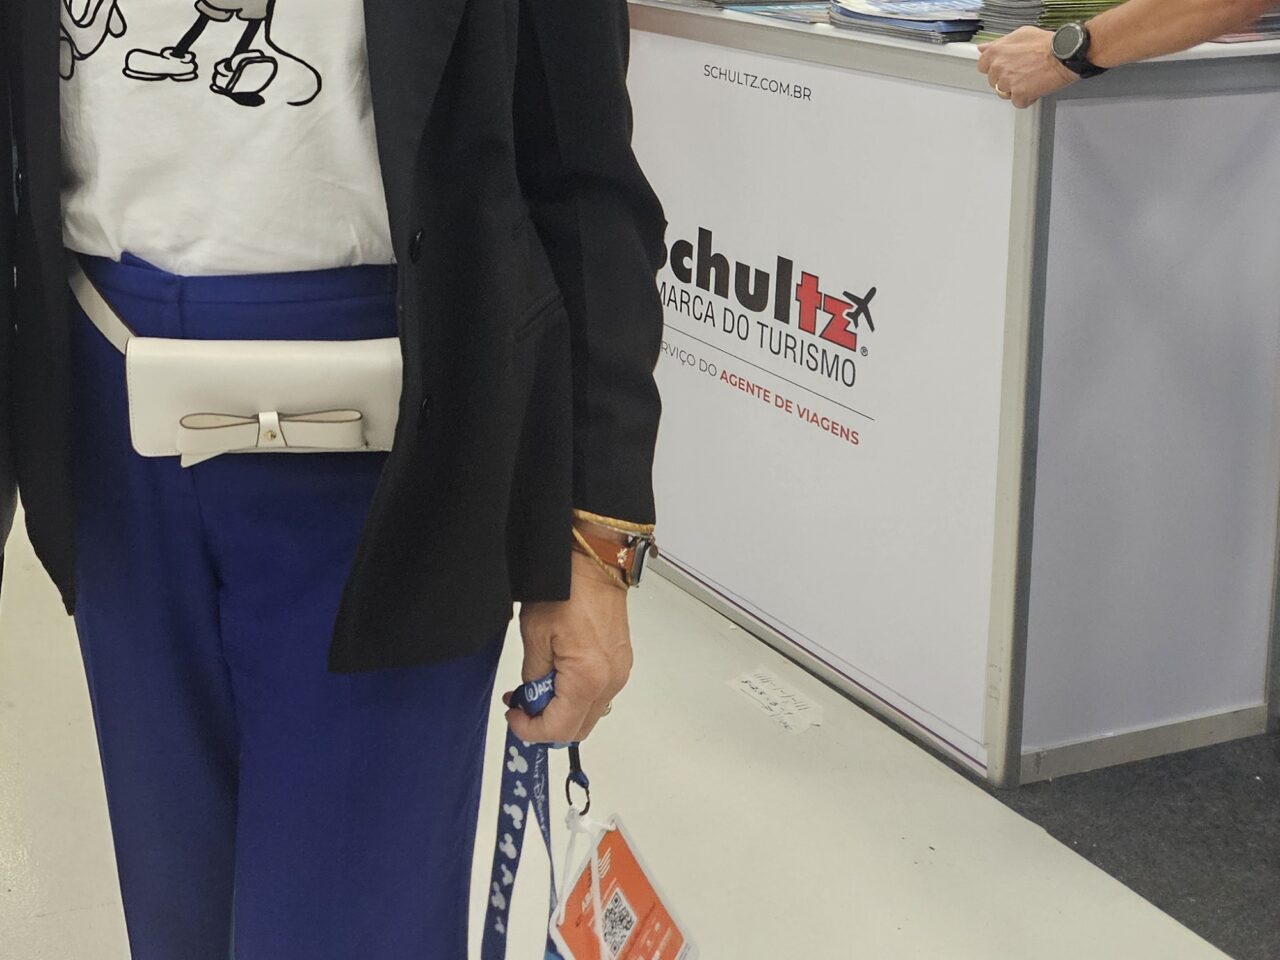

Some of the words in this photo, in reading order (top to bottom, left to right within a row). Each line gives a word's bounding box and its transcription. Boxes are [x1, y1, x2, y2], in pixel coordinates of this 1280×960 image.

[703, 63, 812, 102] SCHULTZ.COM.BR
[658, 226, 858, 353] chultz
[660, 341, 696, 367] RVIÇO
[698, 358, 718, 377] DO
[719, 370, 771, 404] AGENTE
[774, 394, 793, 414] DE
[796, 404, 860, 446] VIAGENS
[723, 306, 750, 341] DO
[756, 321, 857, 388] TURISMO
